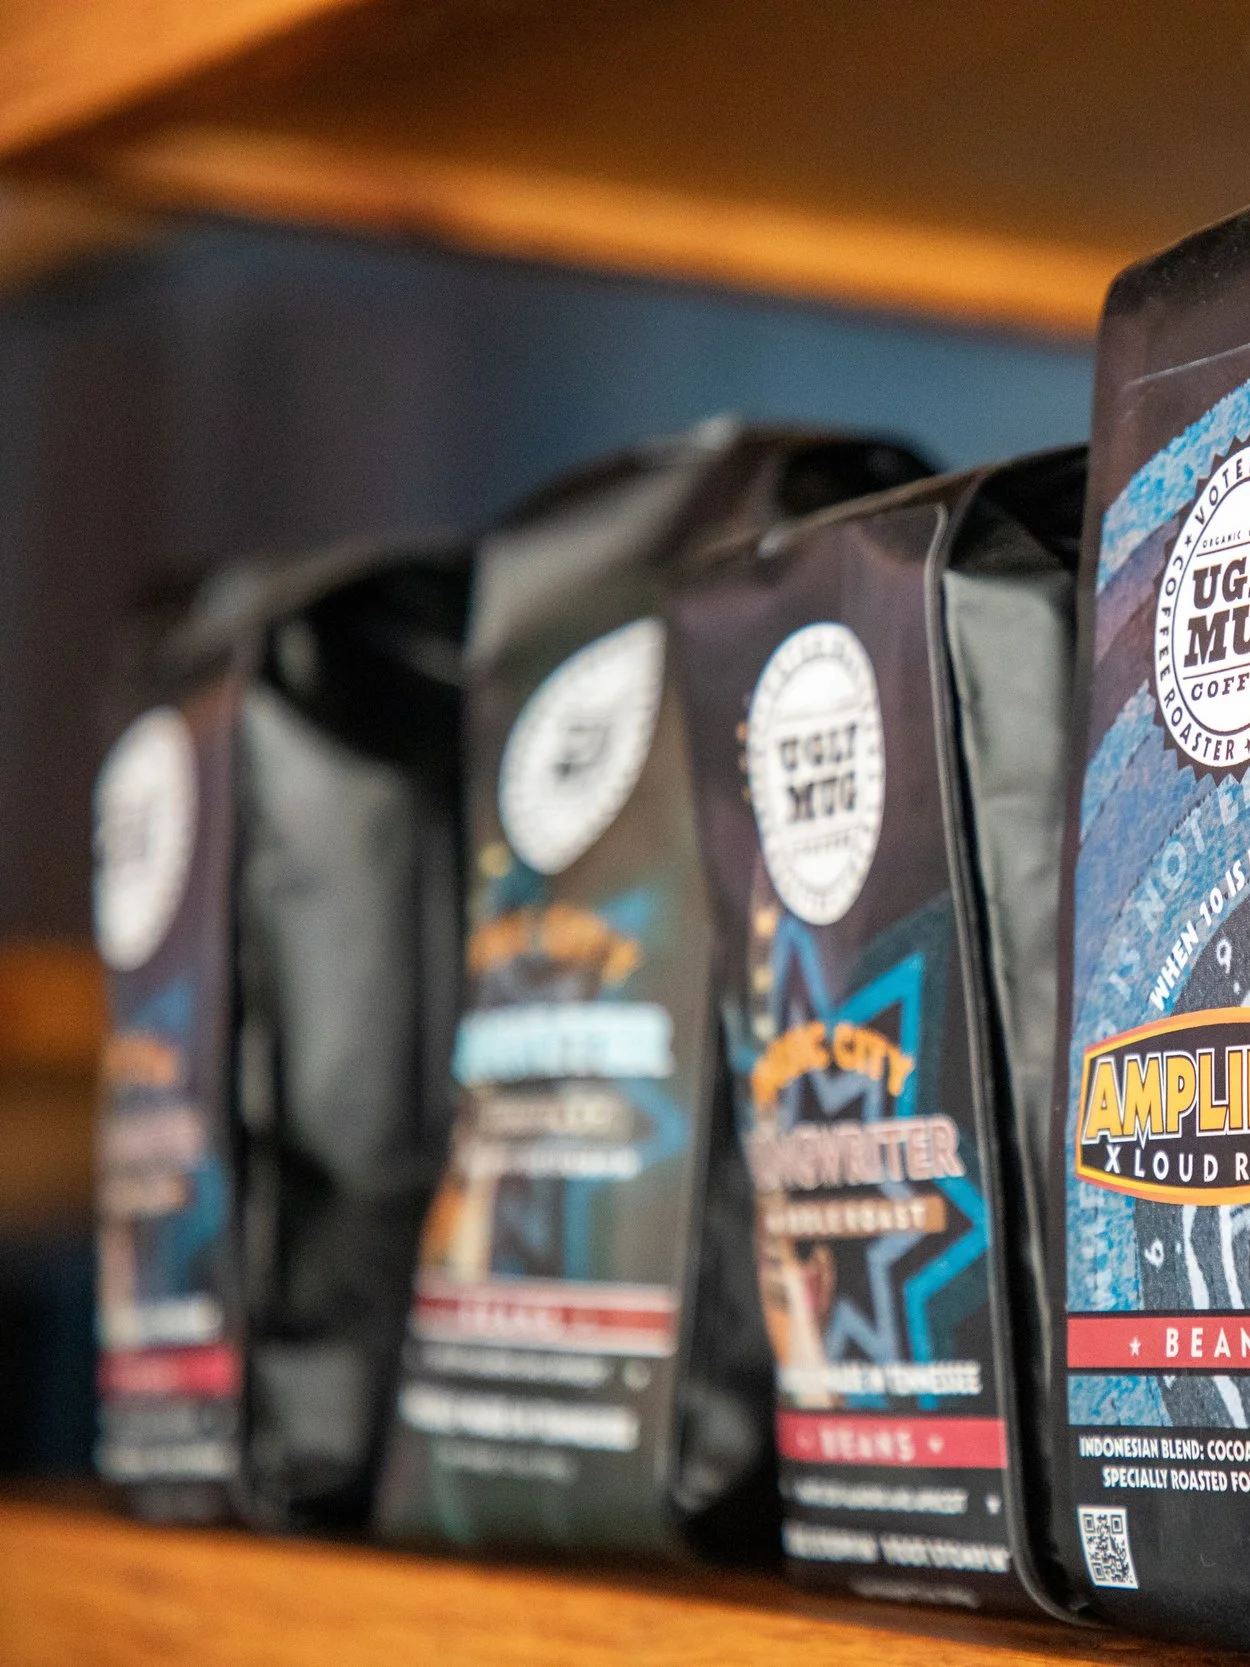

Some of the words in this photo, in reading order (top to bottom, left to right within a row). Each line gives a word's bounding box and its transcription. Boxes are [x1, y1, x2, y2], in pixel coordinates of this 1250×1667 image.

[1202, 531, 1243, 549] ORGANIC
[1157, 558, 1184, 682] COFFEE
[1162, 688, 1236, 762] ROASTER
[1147, 922, 1201, 1013] WHEN
[1223, 863, 1246, 900] IS
[833, 1019, 916, 1098] CITY
[1104, 1144, 1122, 1175] X
[1133, 1148, 1219, 1183] LOUD
[1078, 1435, 1160, 1459] INDONESIAN
[1161, 1438, 1205, 1461] BLEND:
[1102, 1466, 1169, 1490] SPECIALLY
[1170, 1469, 1228, 1493] ROASTED
